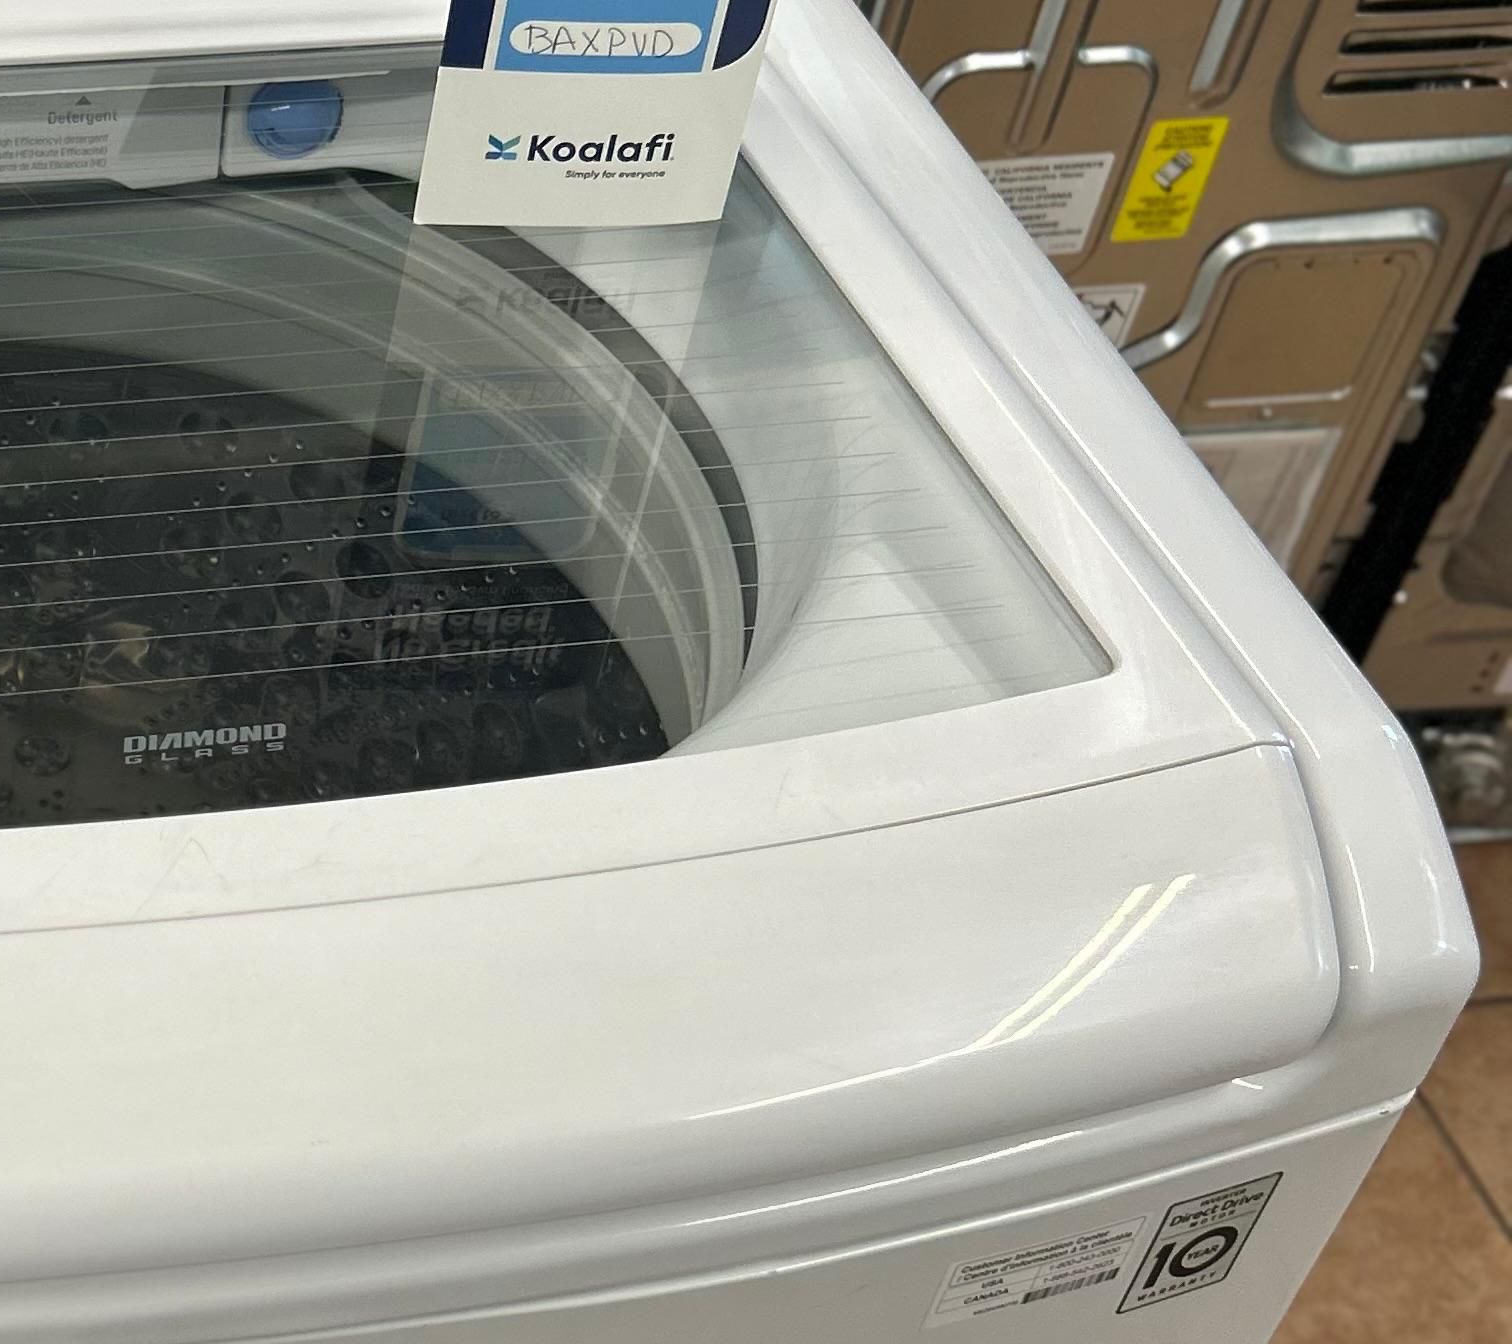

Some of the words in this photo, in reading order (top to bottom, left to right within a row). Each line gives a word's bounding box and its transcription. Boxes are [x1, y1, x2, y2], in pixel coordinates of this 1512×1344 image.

[47, 111, 118, 126] Detergent
[528, 132, 674, 163] Koalafi
[565, 169, 600, 181] Simply
[601, 169, 616, 179] for
[618, 170, 666, 180] everyone
[124, 723, 287, 753] DIAMOND
[125, 741, 284, 765] GLASS
[1169, 1204, 1219, 1227] Direct
[1221, 1192, 1264, 1211] Drive
[1143, 1226, 1238, 1290] 10
[1188, 1244, 1220, 1261] YEAR
[982, 1278, 1004, 1289] USA
[1137, 1271, 1217, 1301] WARRANTY
[964, 1288, 1009, 1305] CANADA
